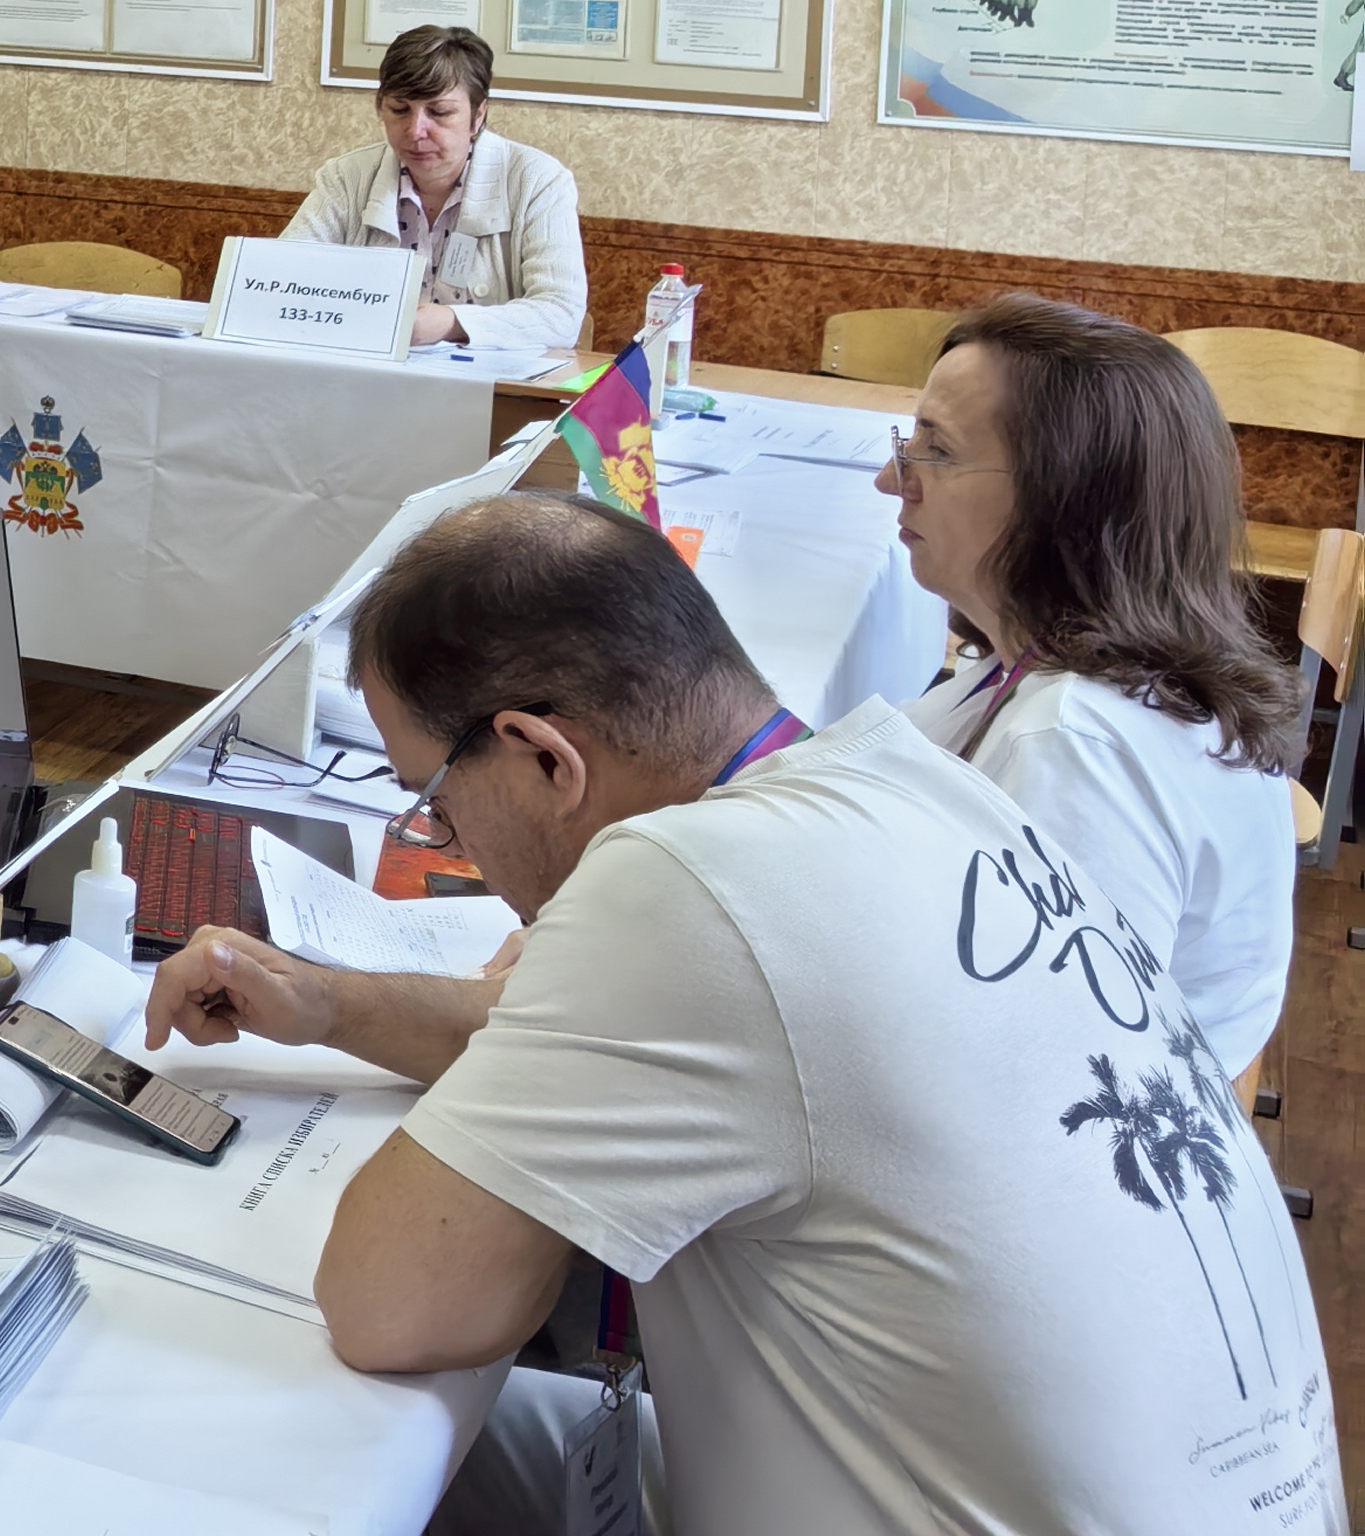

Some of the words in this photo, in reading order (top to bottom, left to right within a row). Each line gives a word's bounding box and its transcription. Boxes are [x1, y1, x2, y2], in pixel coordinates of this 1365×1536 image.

[244, 277, 390, 306] Ул.Р.Люксембург
[278, 307, 343, 325] 133-176
[239, 1181, 273, 1211] КНИГА
[262, 1147, 299, 1182] СПИСКА
[287, 1092, 341, 1147] ИЗБИРАТЕЛЕЙ
[1249, 1474, 1306, 1513] WELCOME
